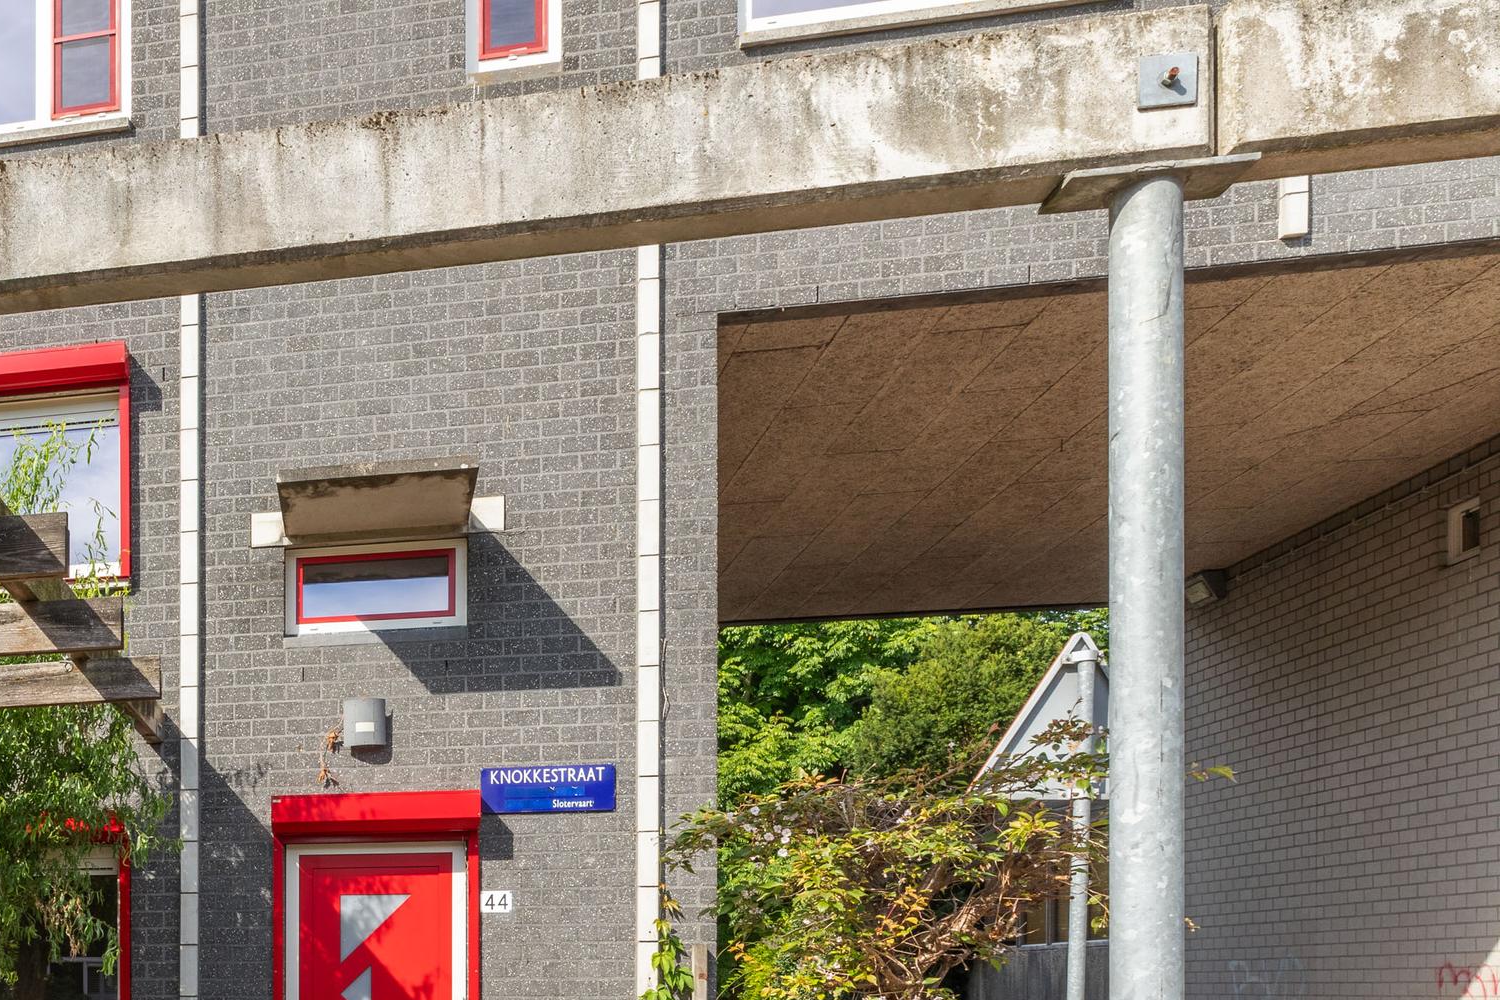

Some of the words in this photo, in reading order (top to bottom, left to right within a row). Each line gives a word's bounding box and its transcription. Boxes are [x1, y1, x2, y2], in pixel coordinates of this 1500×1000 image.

[490, 766, 605, 785] KNOKKESTRAAT
[552, 798, 594, 808] Slotervaart
[485, 894, 509, 910] 44
